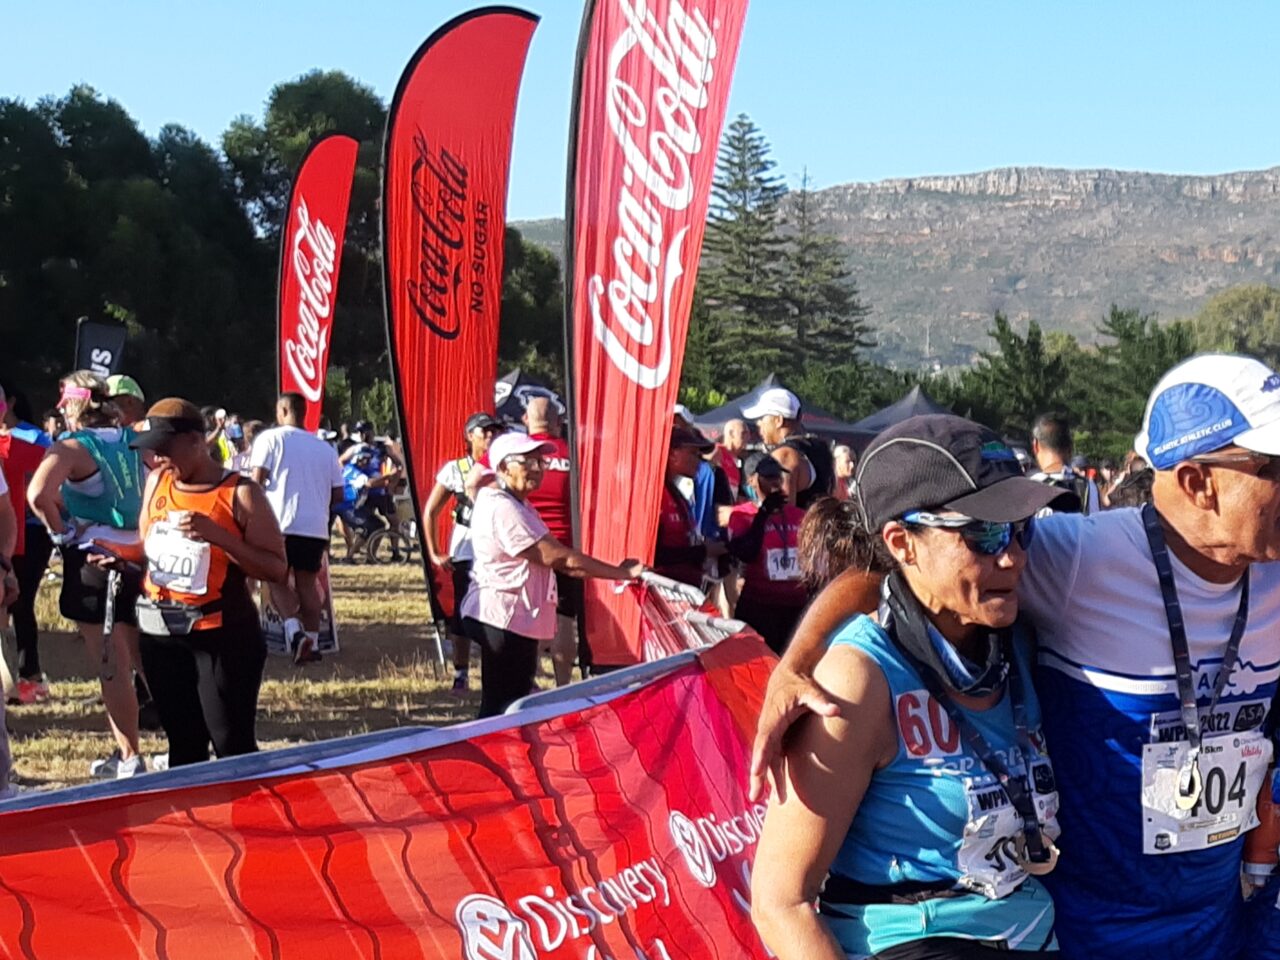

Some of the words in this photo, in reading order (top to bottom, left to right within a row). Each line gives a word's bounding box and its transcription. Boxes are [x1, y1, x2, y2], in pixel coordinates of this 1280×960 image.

[471, 202, 489, 276] SUGAR
[284, 192, 337, 403] Coca-Cola
[470, 280, 485, 314] NO
[1213, 418, 1233, 433] CLUB
[897, 692, 961, 757] 60
[1201, 711, 1231, 734] 2022
[1237, 704, 1265, 722] ASA
[517, 854, 673, 953] Discovery
